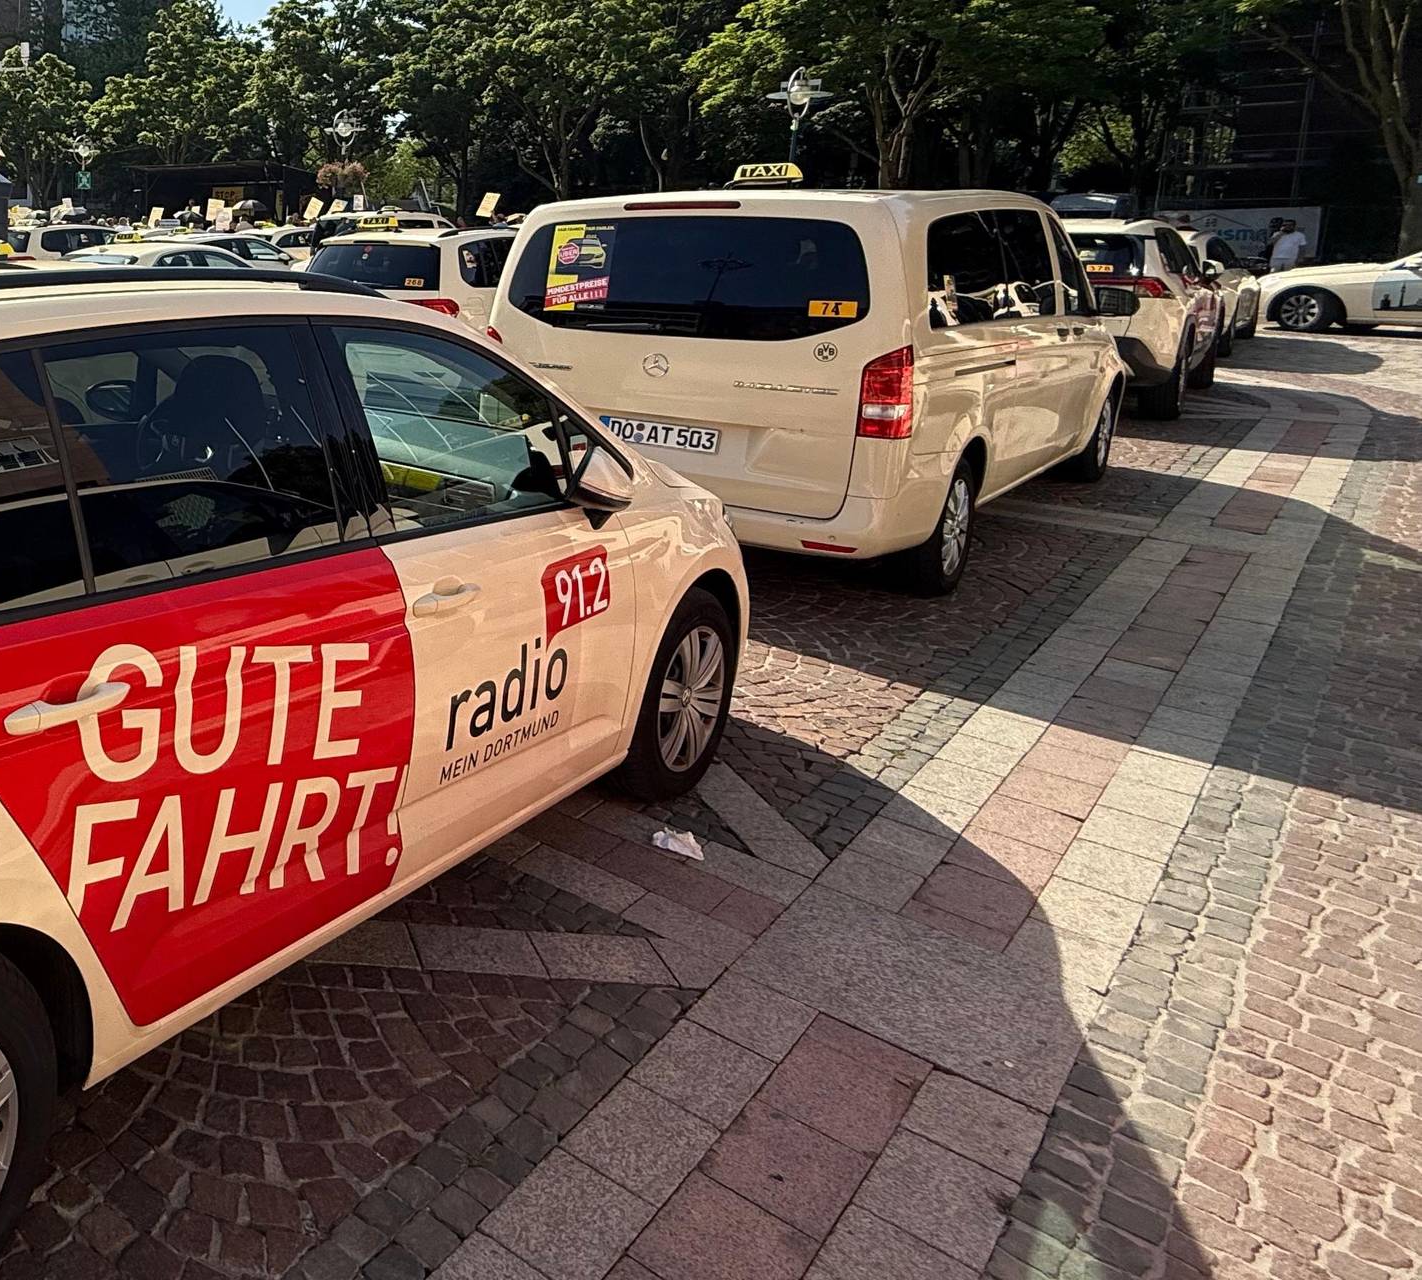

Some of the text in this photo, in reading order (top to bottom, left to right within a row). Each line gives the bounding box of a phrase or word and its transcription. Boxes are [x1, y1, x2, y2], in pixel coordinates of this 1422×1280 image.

[743, 165, 787, 177] TAXI
[547, 279, 608, 296] MINDESTPREISE
[552, 295, 568, 305] FÜR
[817, 344, 835, 357] BVB
[610, 420, 716, 451] DO AT 503
[555, 557, 609, 626] 91.2
[77, 642, 371, 783] GUTE
[445, 637, 568, 752] radio
[439, 710, 560, 785] MEIN DORTMUND
[67, 763, 410, 933] FAHRT!
